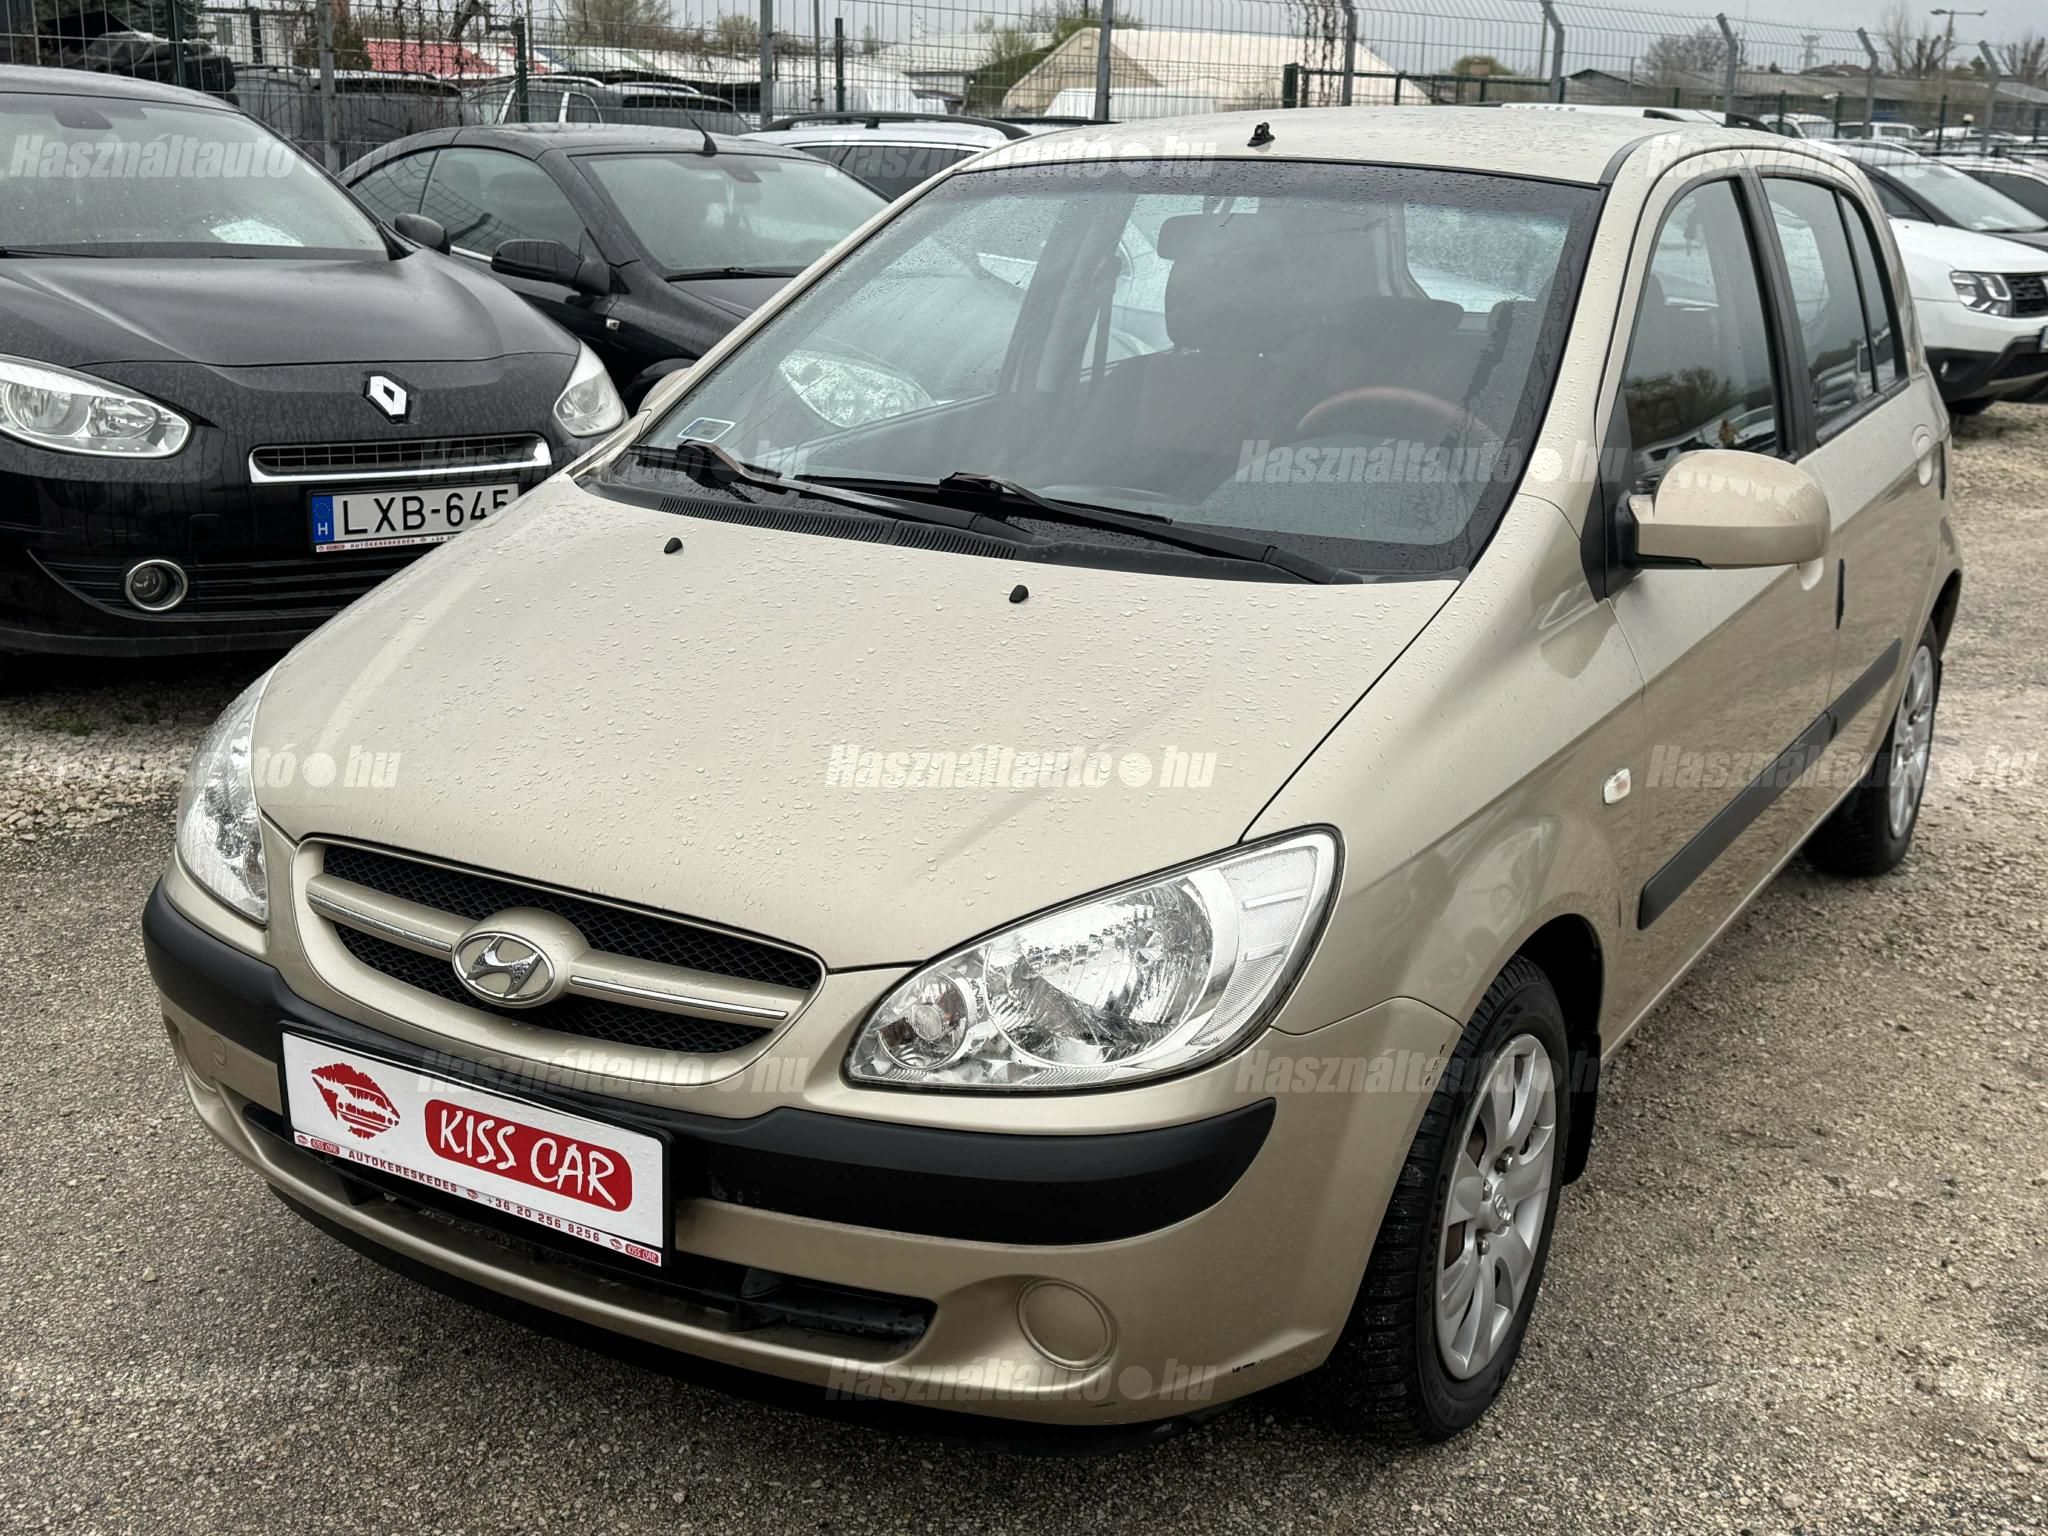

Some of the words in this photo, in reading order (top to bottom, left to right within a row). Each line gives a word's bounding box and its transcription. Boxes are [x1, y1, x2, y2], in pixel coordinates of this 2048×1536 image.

[440, 1108, 517, 1170] KISS
[530, 1137, 617, 1207] CAR
[486, 1195, 511, 1212] +36
[516, 1206, 532, 1219] 20
[538, 1213, 561, 1229] 256
[568, 1224, 600, 1242] 8256
